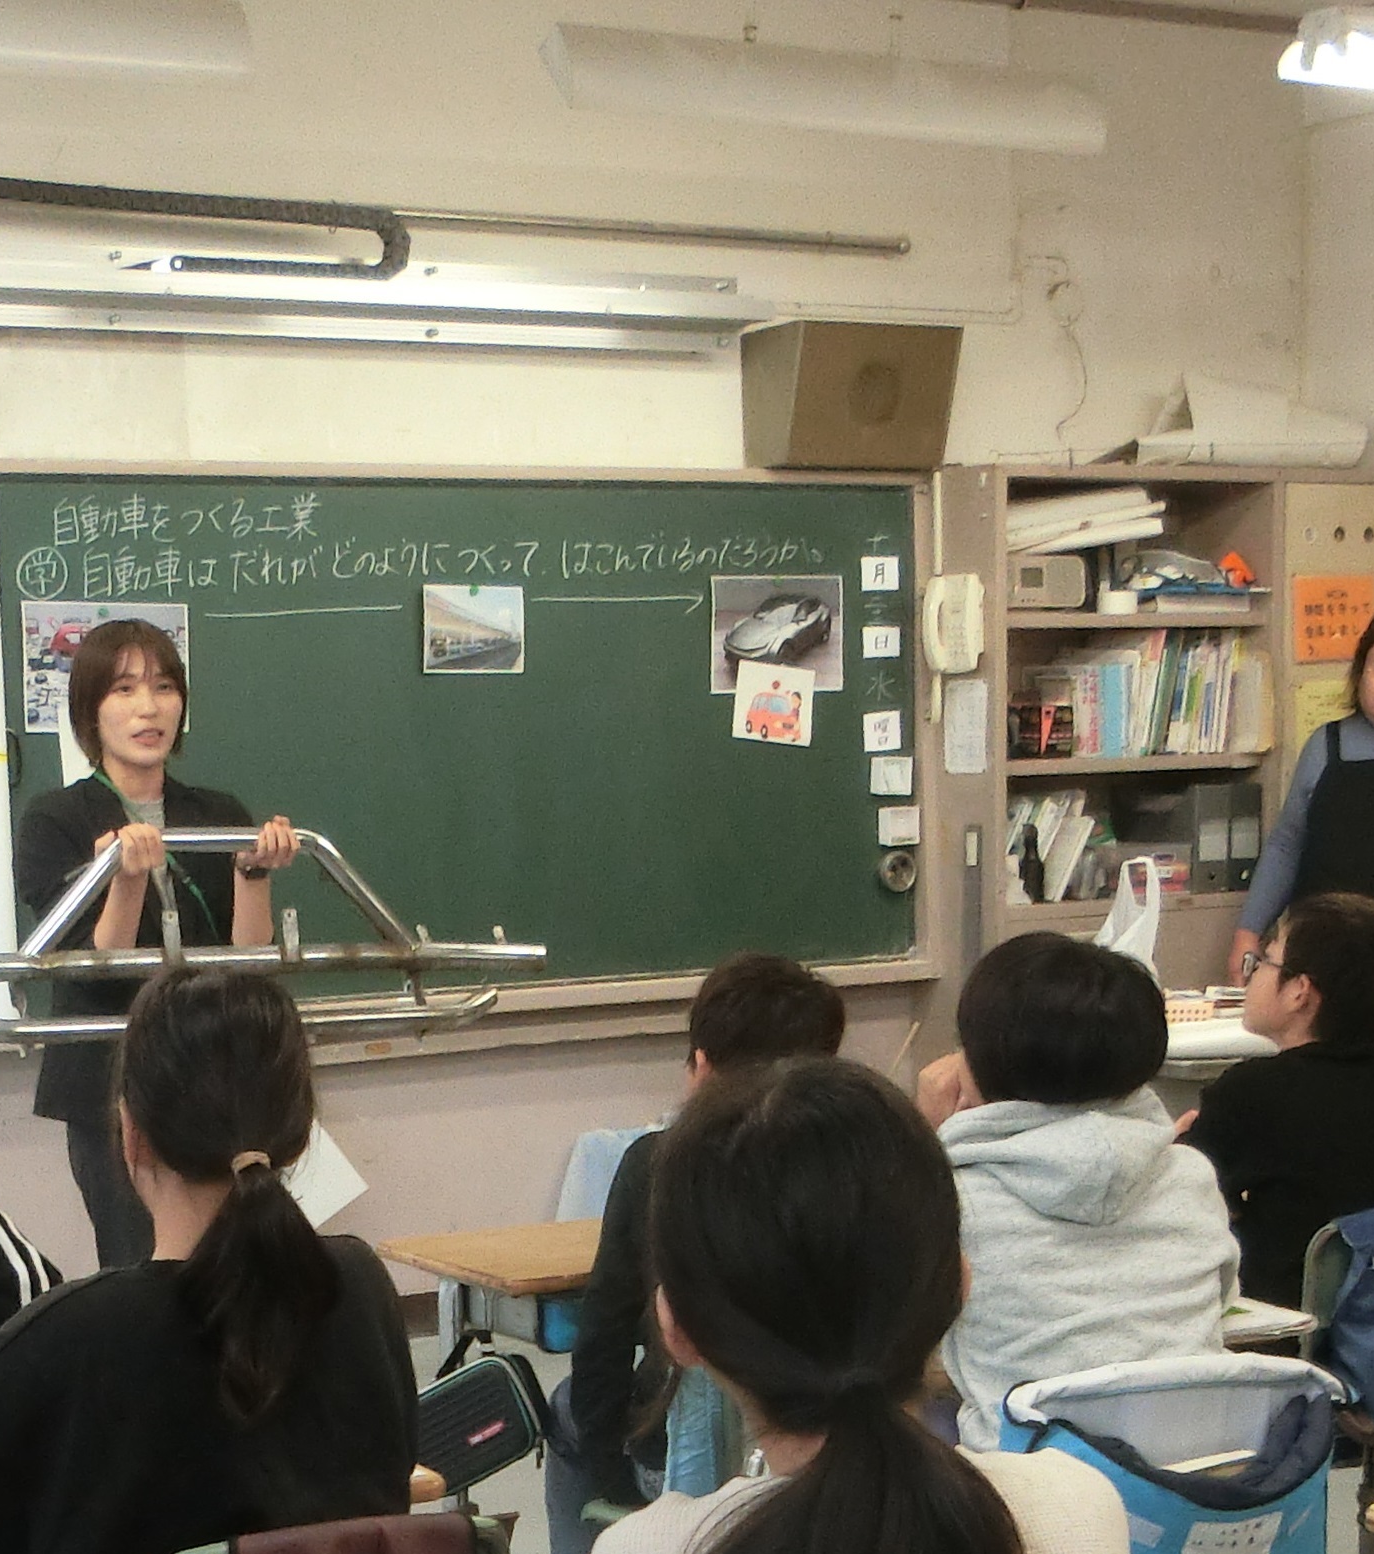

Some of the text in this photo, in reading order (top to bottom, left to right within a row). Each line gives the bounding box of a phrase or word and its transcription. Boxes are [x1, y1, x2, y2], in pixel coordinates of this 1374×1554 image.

[53, 492, 322, 546] 自動車をつくる工業
